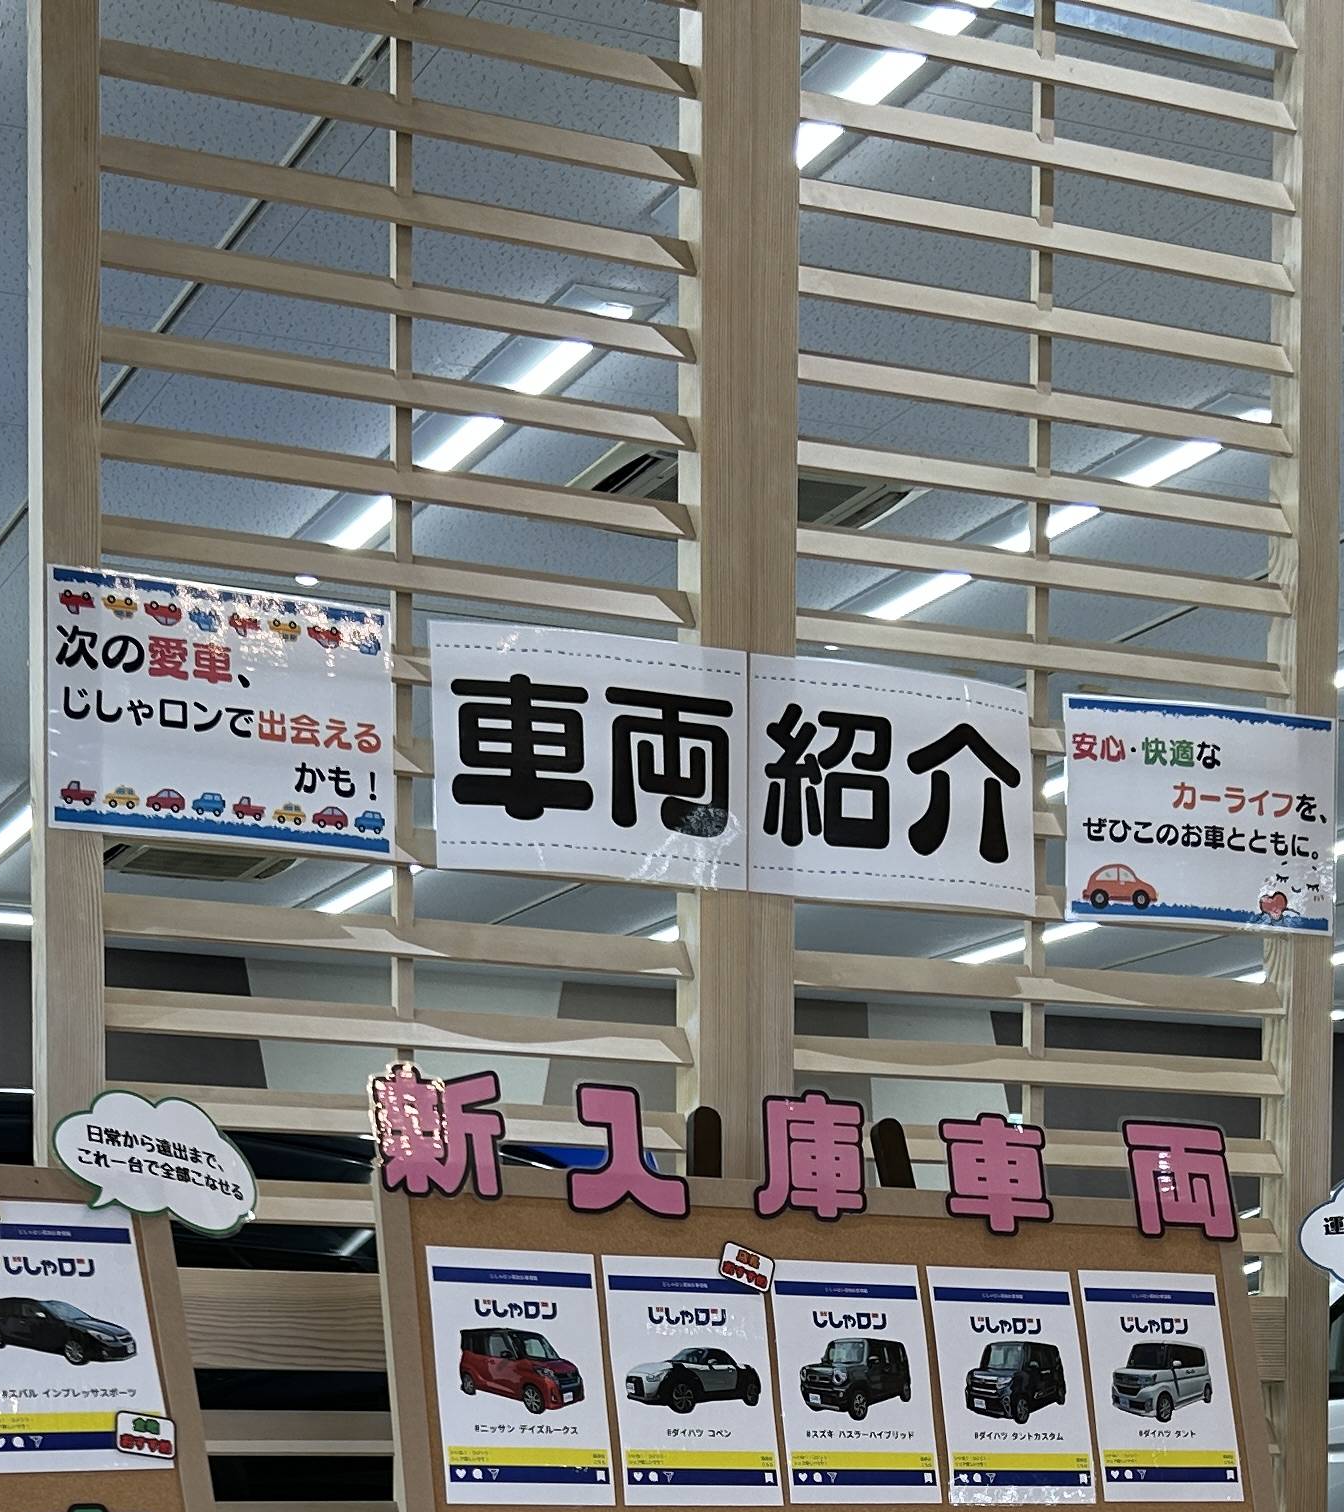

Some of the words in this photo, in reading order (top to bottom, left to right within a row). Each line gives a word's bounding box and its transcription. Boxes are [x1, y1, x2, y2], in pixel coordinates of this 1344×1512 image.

[55, 625, 250, 688] 次の愛車、
[63, 687, 382, 754] じしゃロンで出会える
[451, 673, 1020, 864] 車両紹介
[1072, 733, 1221, 769] 安心・快適な
[294, 762, 377, 801] かも！
[1172, 781, 1327, 824] カーライフを、
[1083, 817, 1318, 860] ぜひこのお車とともに。
[86, 1124, 224, 1172] 日常から遠出まで、
[369, 1062, 1238, 1240] 新入庫車両
[77, 1148, 244, 1201] これ一台で全部こなせる
[3, 1256, 95, 1277] じしゃロン
[474, 1299, 557, 1320] じしゃロン
[648, 1306, 726, 1327] じしゃロン
[813, 1310, 887, 1331] じしゃロン
[969, 1316, 1041, 1336] じしゃロン
[1120, 1316, 1189, 1335] じしゃロン
